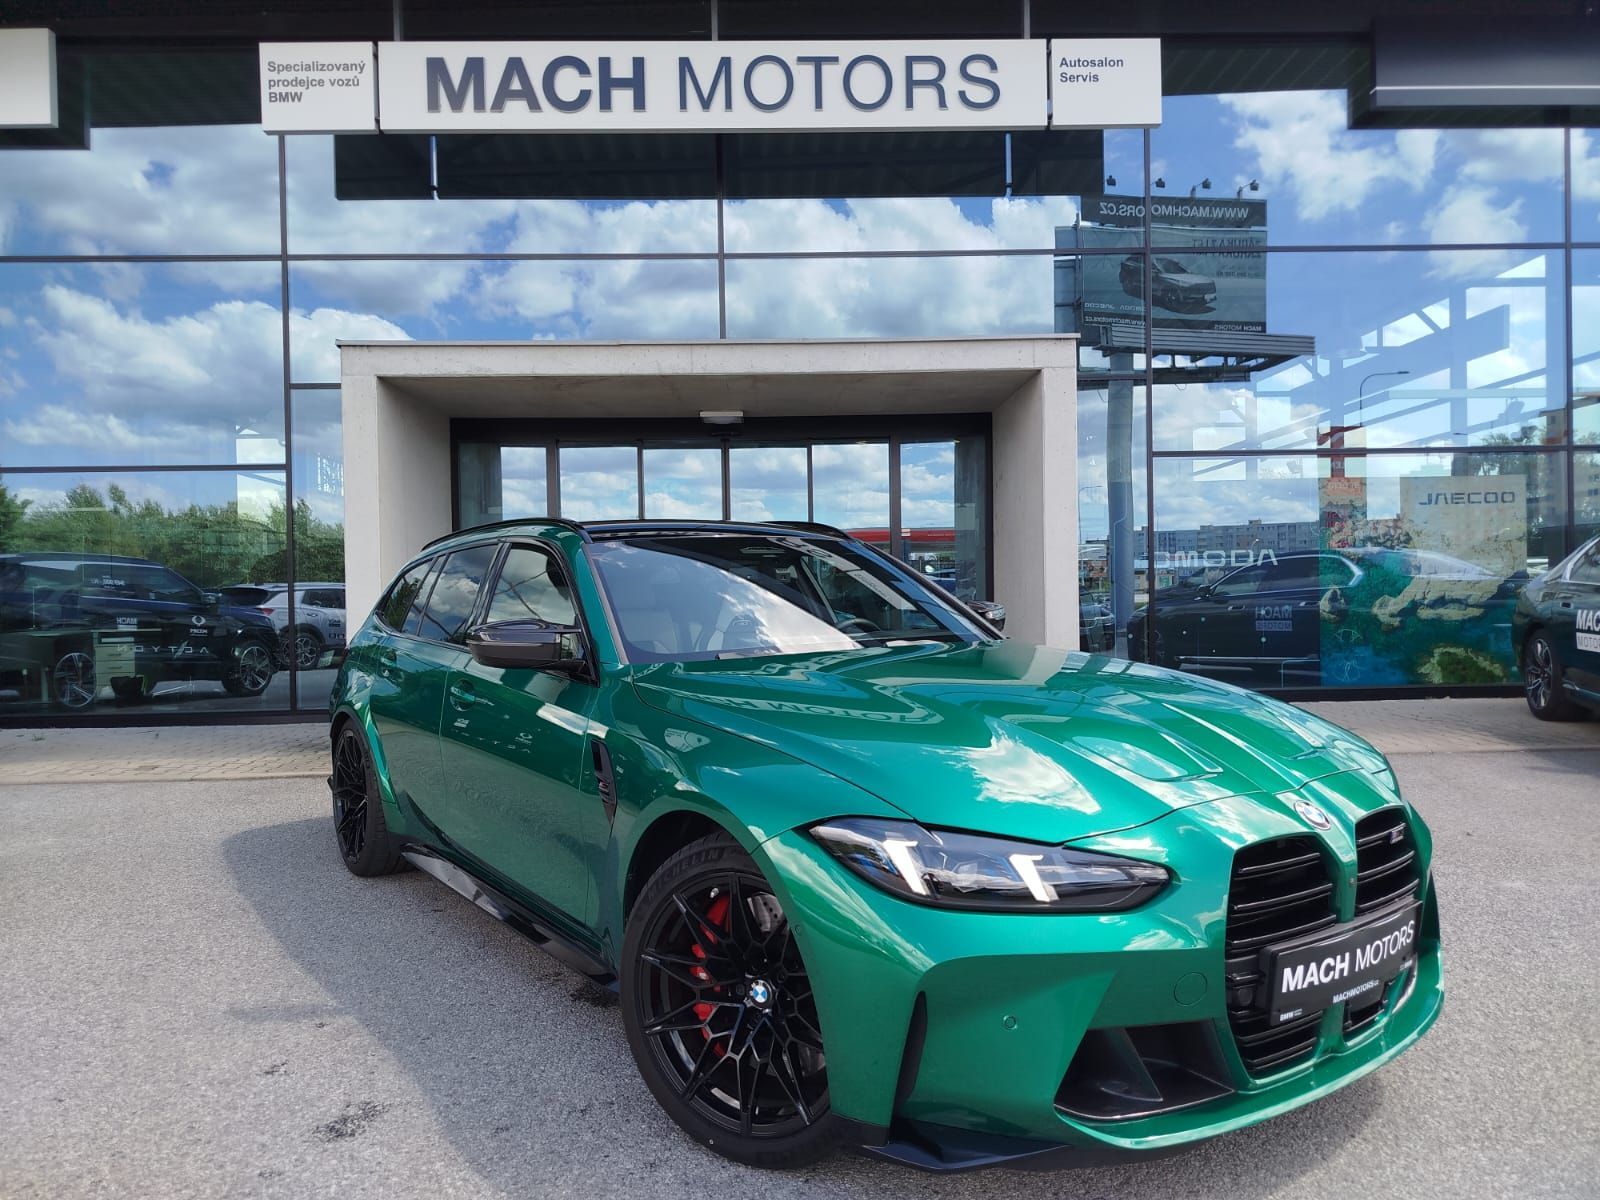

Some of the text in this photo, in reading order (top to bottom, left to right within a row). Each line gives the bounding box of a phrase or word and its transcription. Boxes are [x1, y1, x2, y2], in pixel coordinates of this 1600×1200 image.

[267, 60, 366, 75] Specializovaný
[1059, 57, 1124, 68] Autosalon
[268, 75, 360, 90] prodejce vozů
[426, 54, 1001, 113] MACH MOTORS
[1059, 72, 1100, 83] Servis
[268, 91, 303, 103] BMW
[1418, 491, 1515, 506] JAECOO
[1577, 635, 1600, 650] MOTO
[1281, 920, 1415, 993] MACH MOTORS
